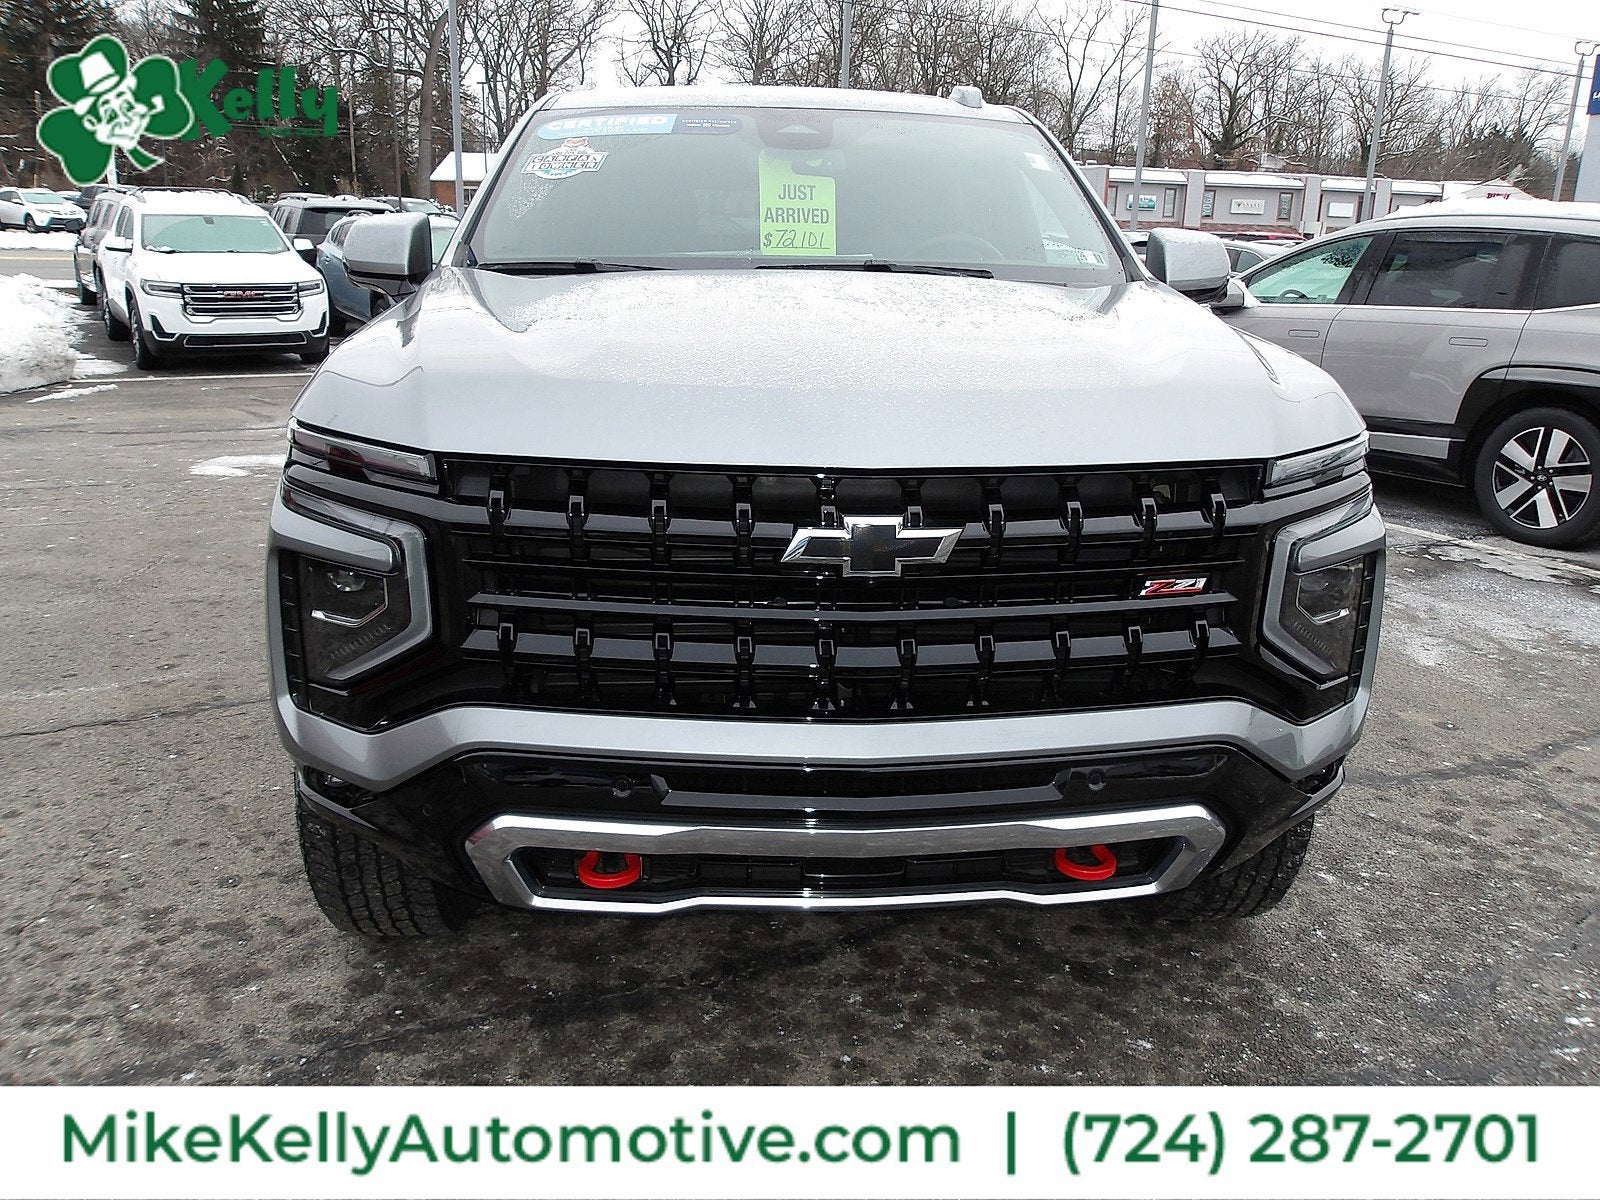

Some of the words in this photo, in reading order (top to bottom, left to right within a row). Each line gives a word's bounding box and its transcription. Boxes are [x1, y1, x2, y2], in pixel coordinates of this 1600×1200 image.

[545, 115, 669, 131] CERTIFIED
[778, 184, 816, 200] JUST
[1202, 192, 1214, 216] YOGA
[763, 207, 830, 224] ARRIVED
[223, 290, 265, 298] GMC
[1140, 578, 1207, 596] Z71
